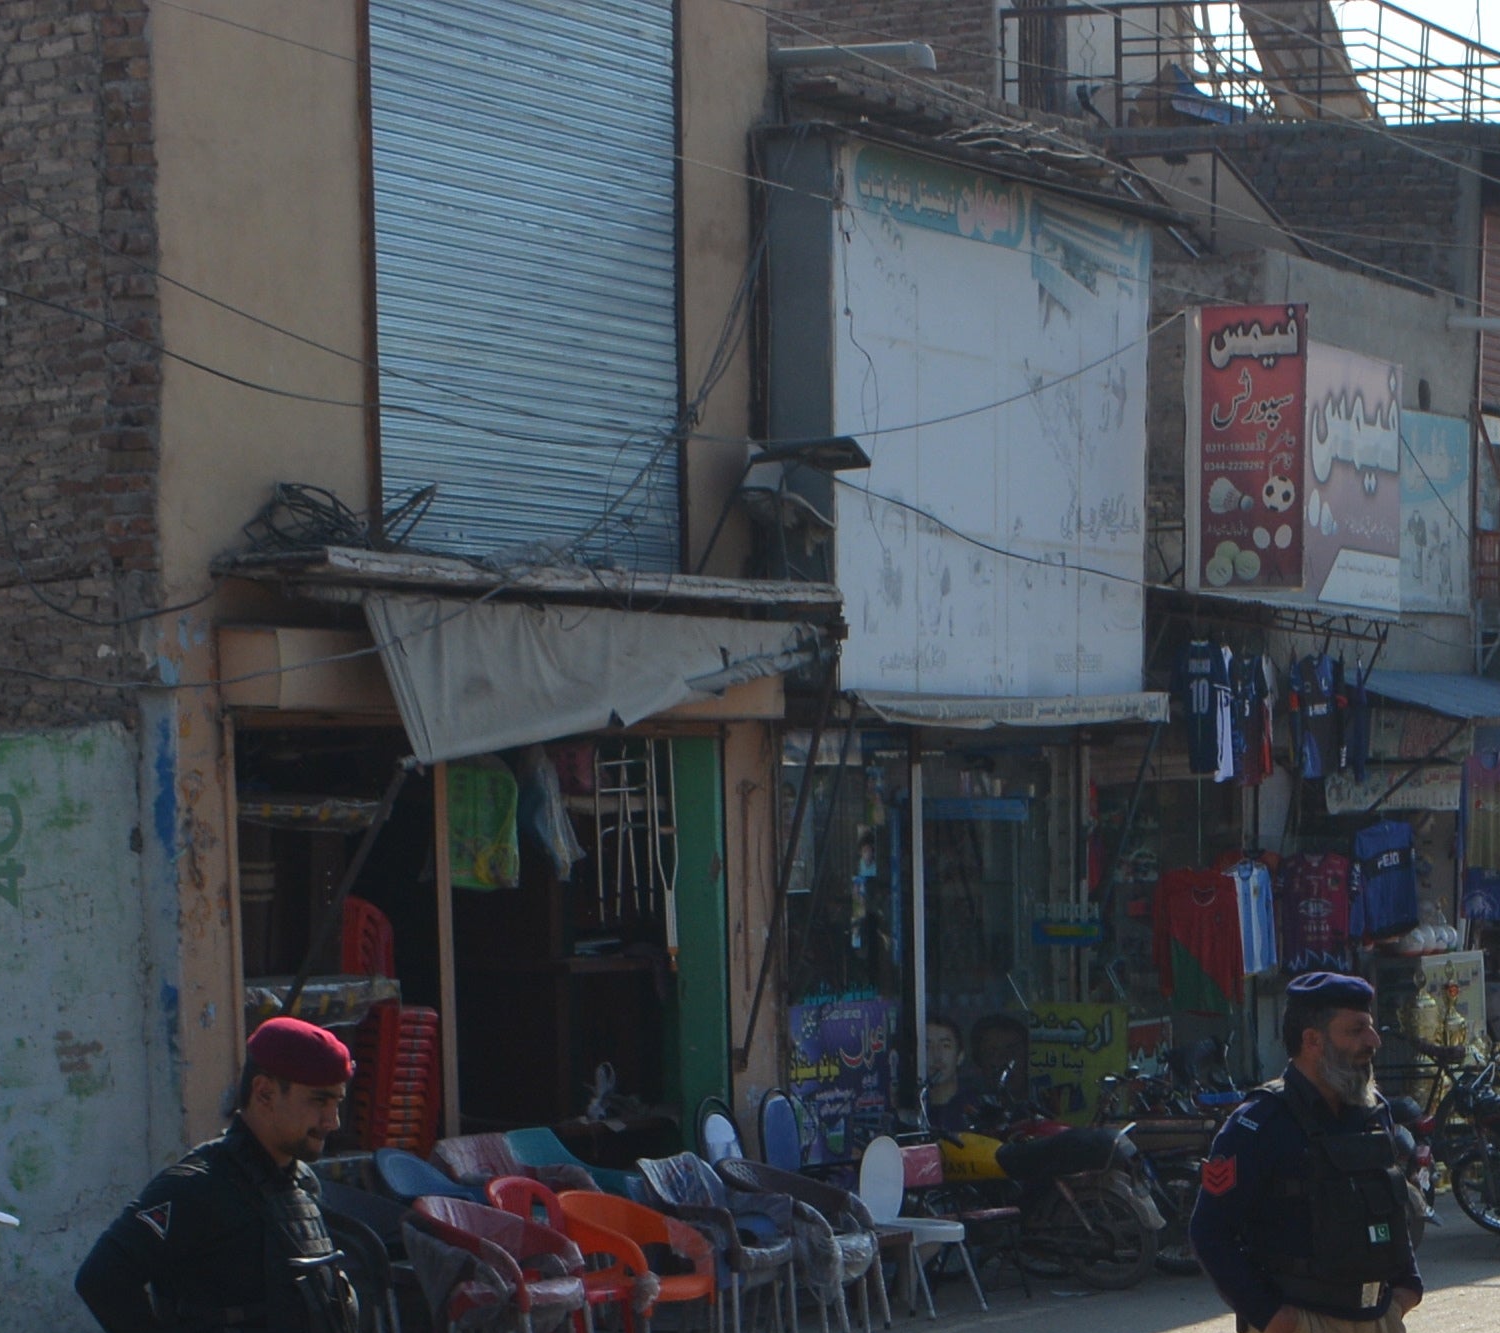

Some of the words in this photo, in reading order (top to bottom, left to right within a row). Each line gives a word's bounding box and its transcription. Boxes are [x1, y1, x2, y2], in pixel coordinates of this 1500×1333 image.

[1209, 305, 1299, 369] فیمس
[1211, 367, 1295, 431] سپورٹس
[1312, 371, 1399, 493] فیمس
[1189, 677, 1210, 715] 10
